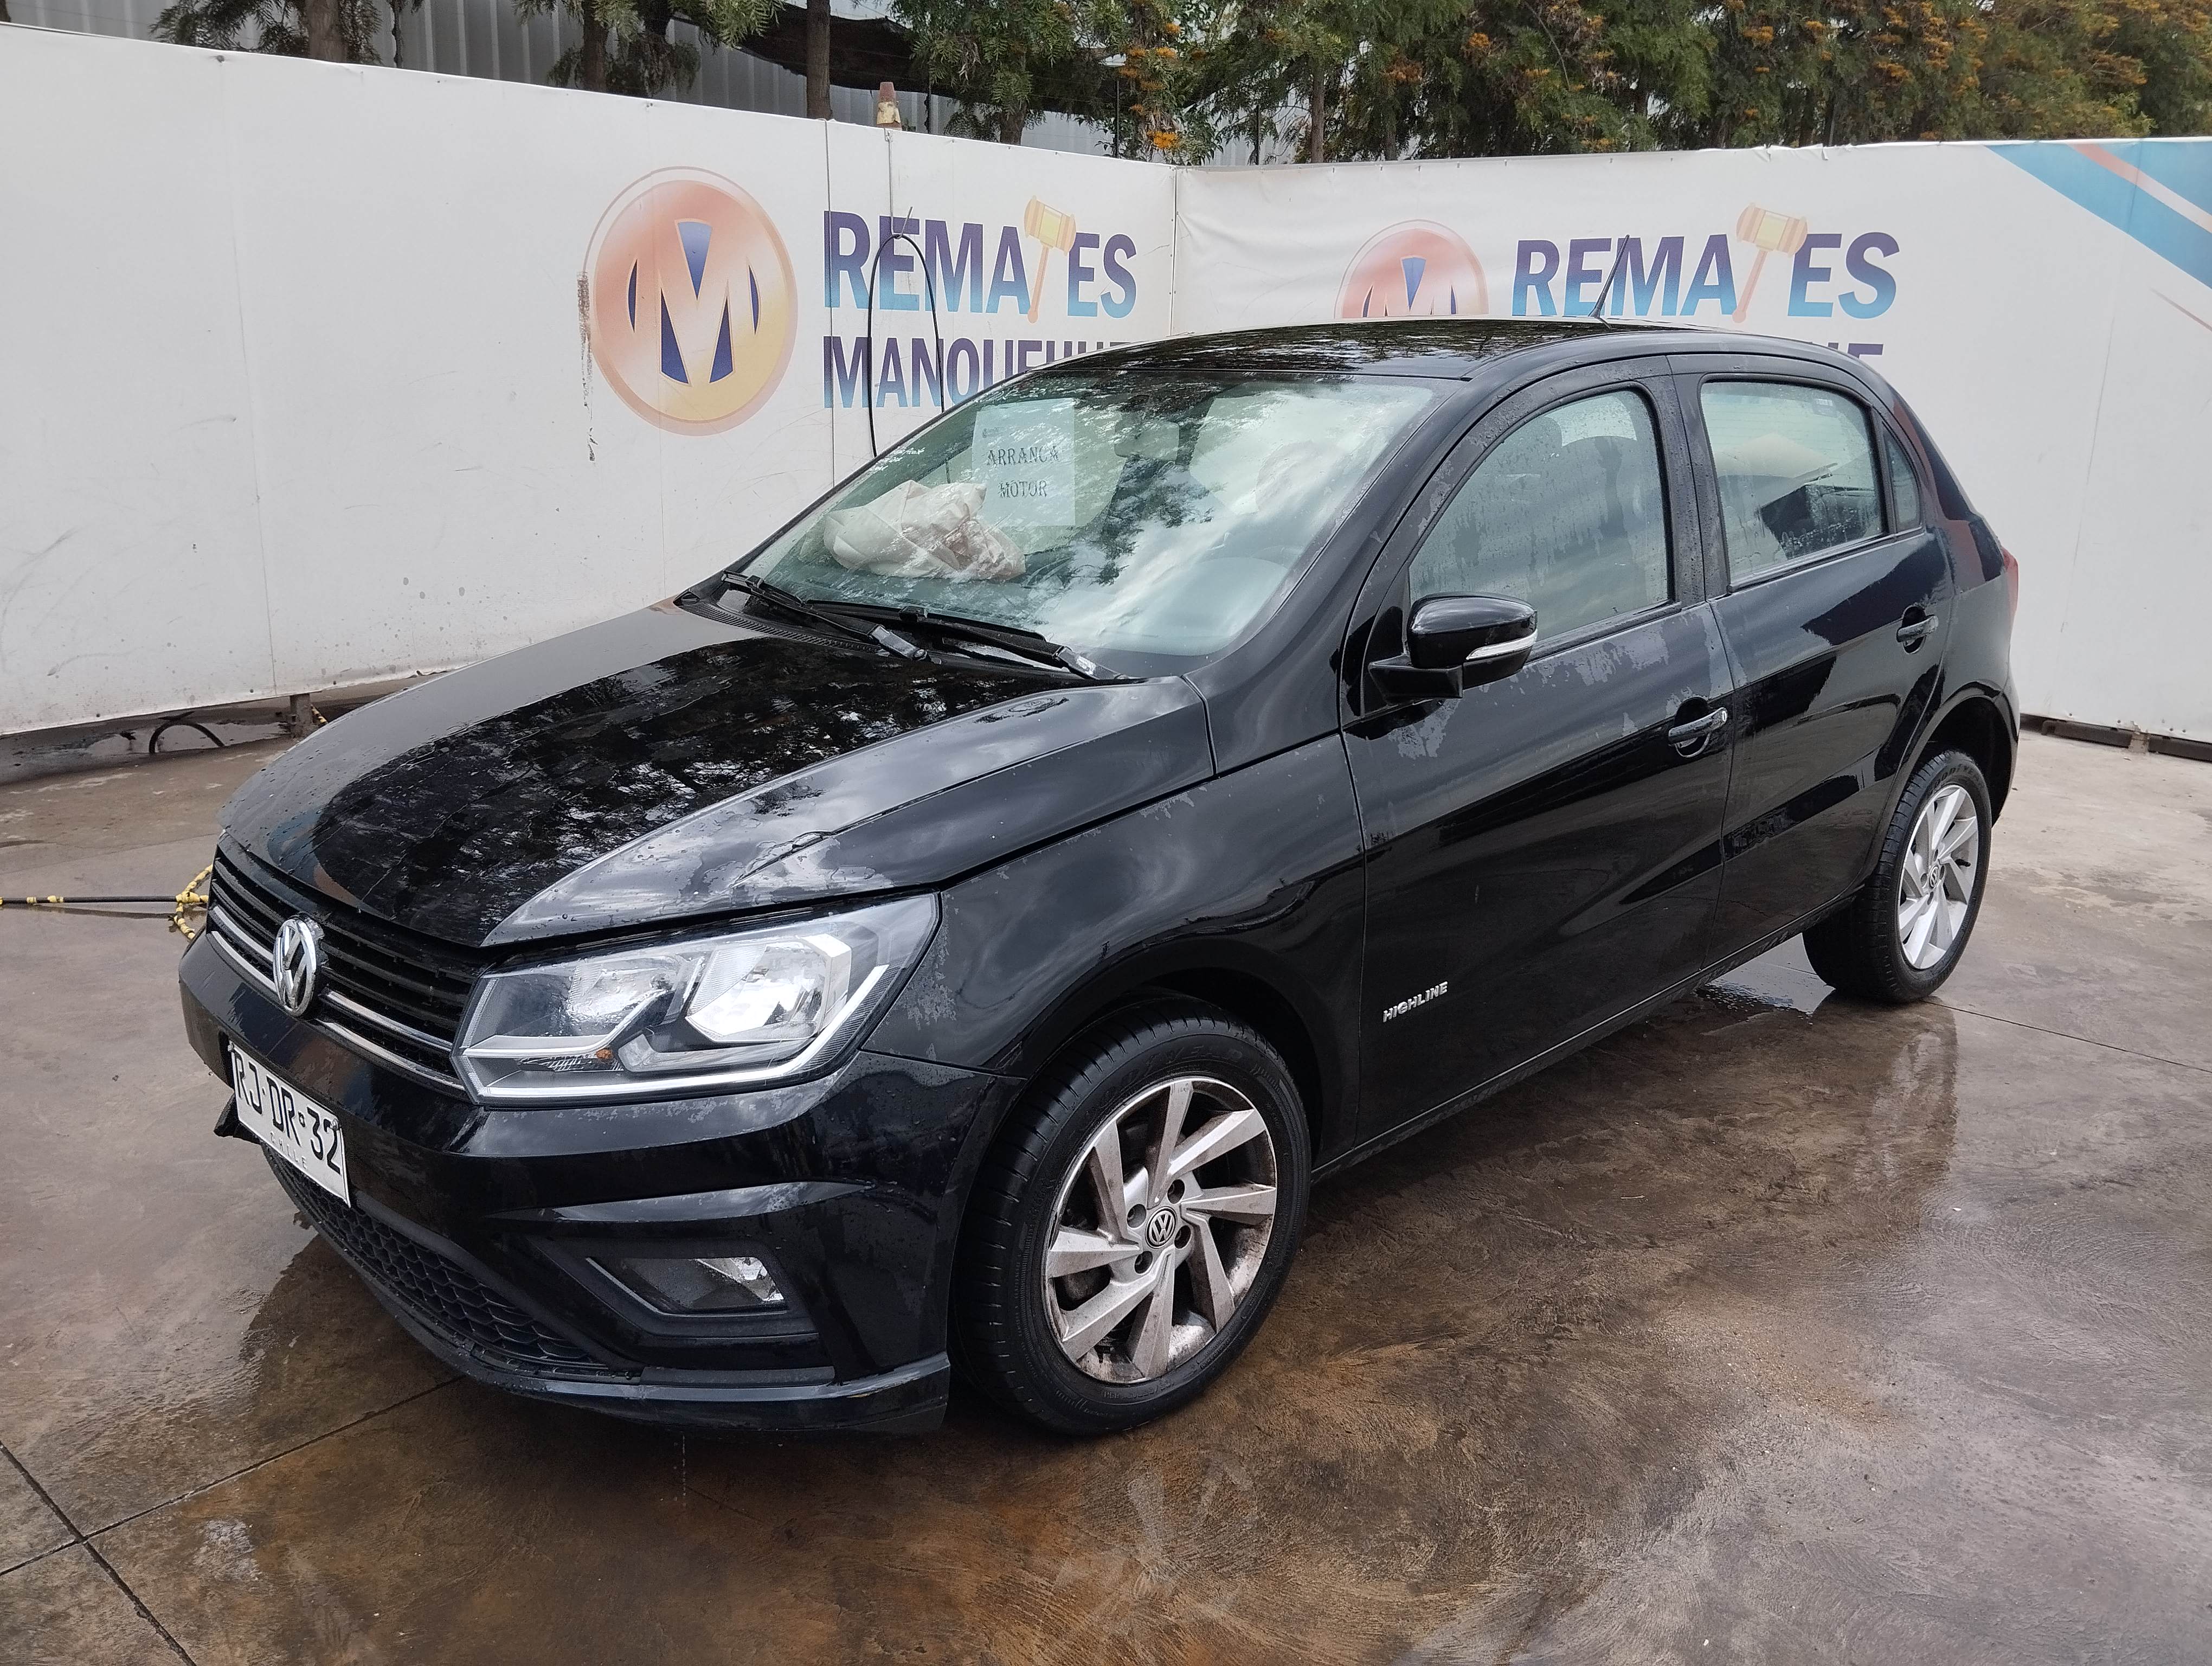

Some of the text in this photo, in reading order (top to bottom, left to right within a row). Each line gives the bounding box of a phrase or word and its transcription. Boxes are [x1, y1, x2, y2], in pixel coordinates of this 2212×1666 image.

[823, 336, 1133, 408] MANQU
[986, 445, 1059, 465] ARRANCA
[998, 480, 1047, 498] MOTOR
[1383, 981, 1448, 1022] HIGHLINE
